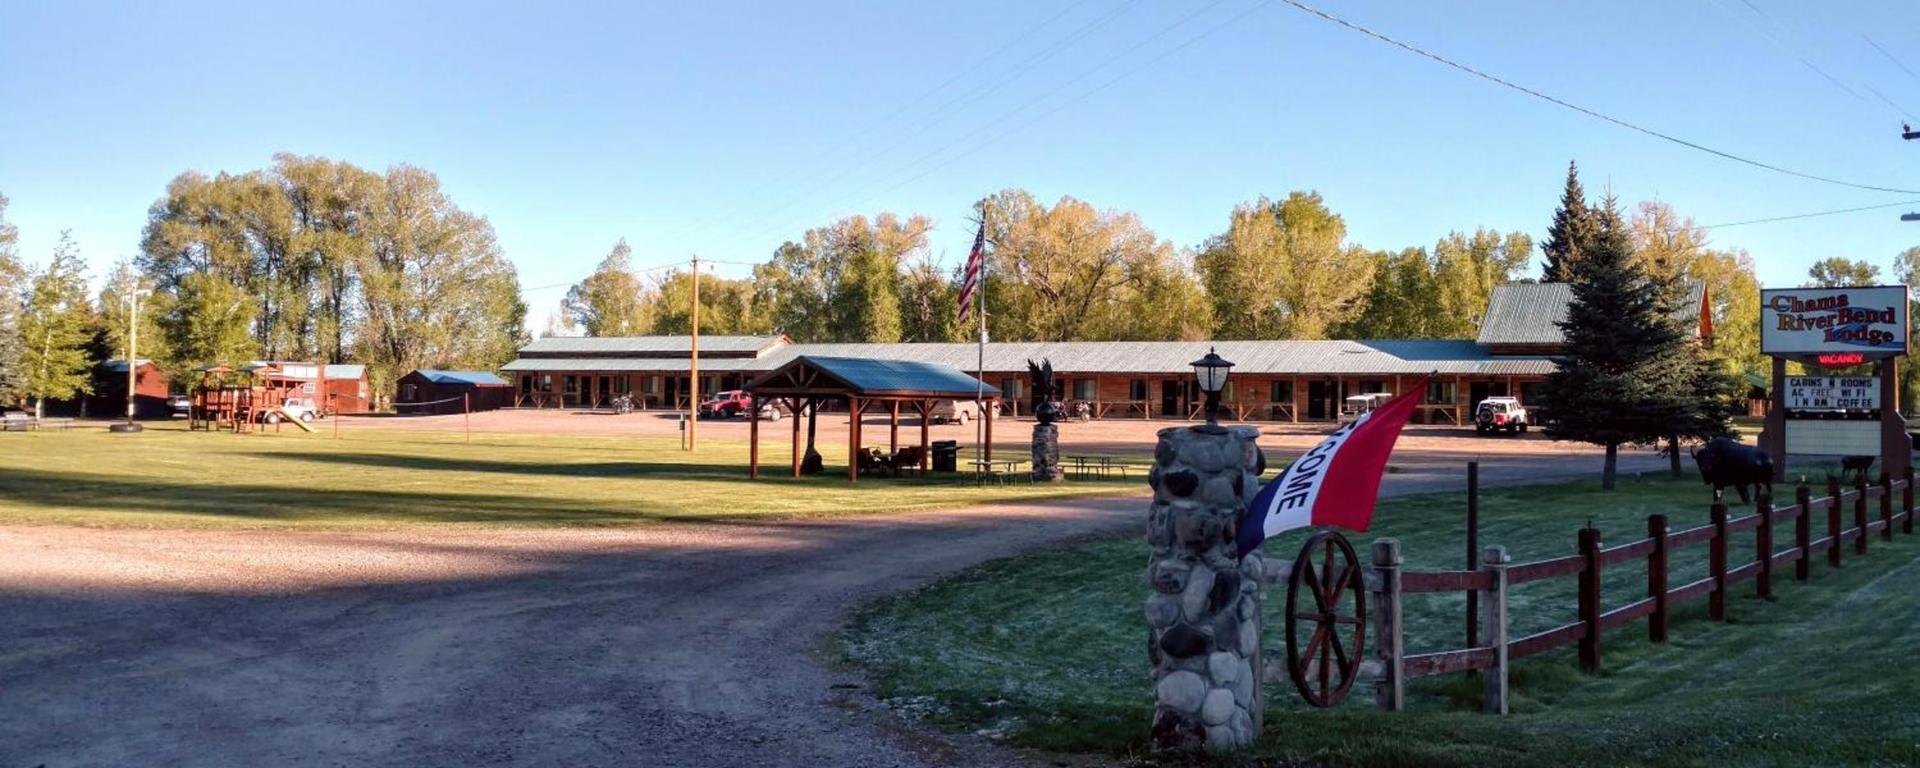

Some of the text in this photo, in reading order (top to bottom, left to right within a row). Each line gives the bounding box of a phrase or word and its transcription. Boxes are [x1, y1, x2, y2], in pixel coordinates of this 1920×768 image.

[1777, 306, 1897, 331] RiverBend
[1823, 325, 1894, 345] Lodge
[1818, 354, 1864, 364] VACANCY
[1790, 378, 1823, 388] CABINS
[1840, 378, 1873, 388] ROOMS
[1791, 388, 1804, 397] AC
[1810, 389, 1831, 397] FREE
[1814, 398, 1828, 407] RM
[1837, 398, 1873, 407] COFFEE
